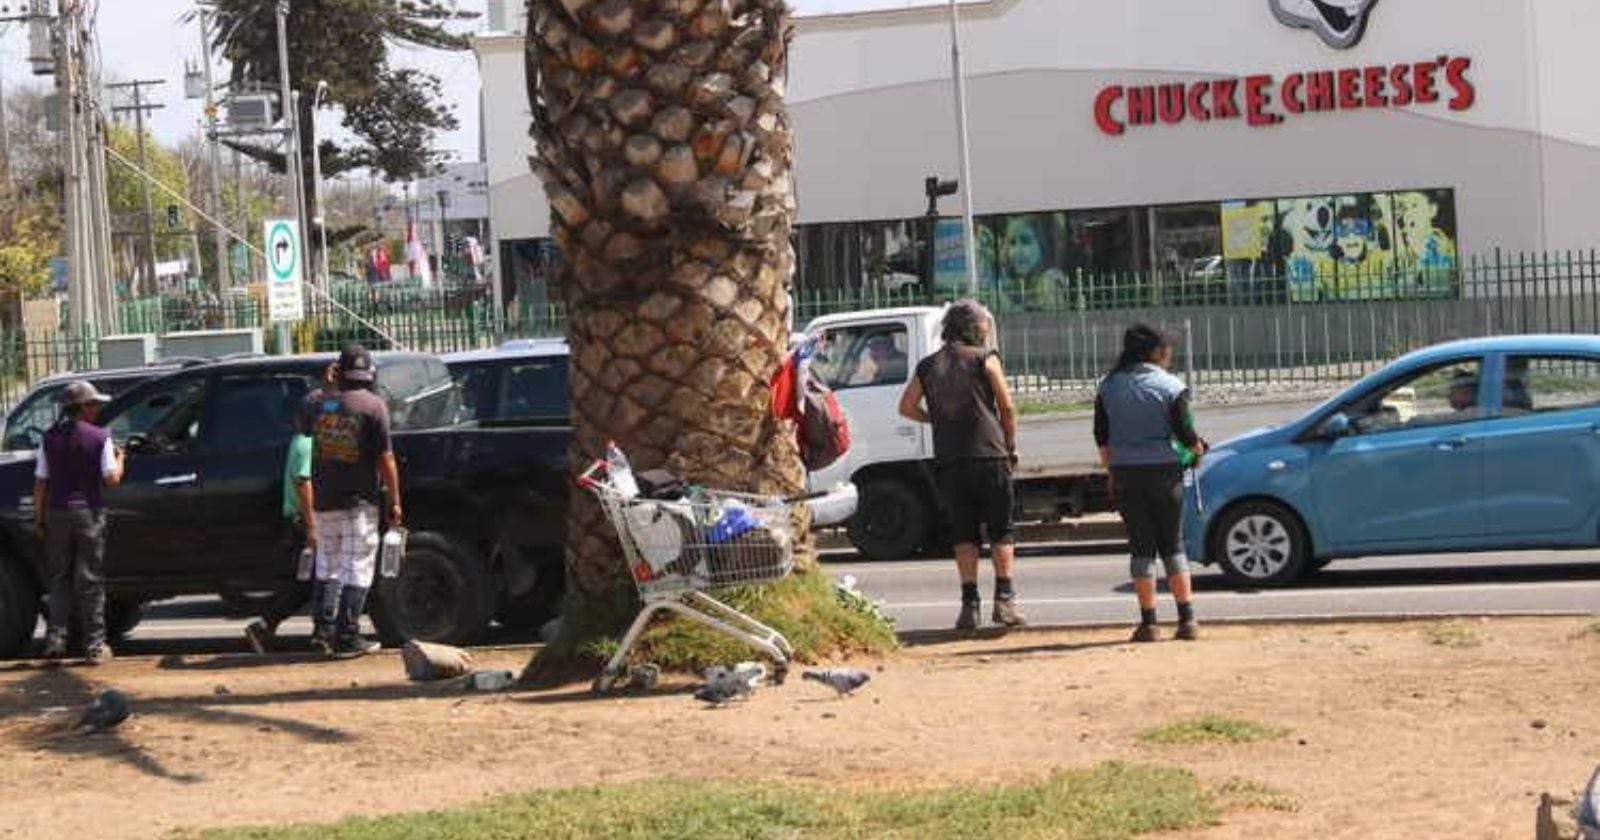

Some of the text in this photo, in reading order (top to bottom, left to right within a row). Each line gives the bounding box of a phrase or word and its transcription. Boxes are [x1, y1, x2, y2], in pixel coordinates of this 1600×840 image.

[1094, 55, 1475, 136] CHUCK E. CHEESE'S
